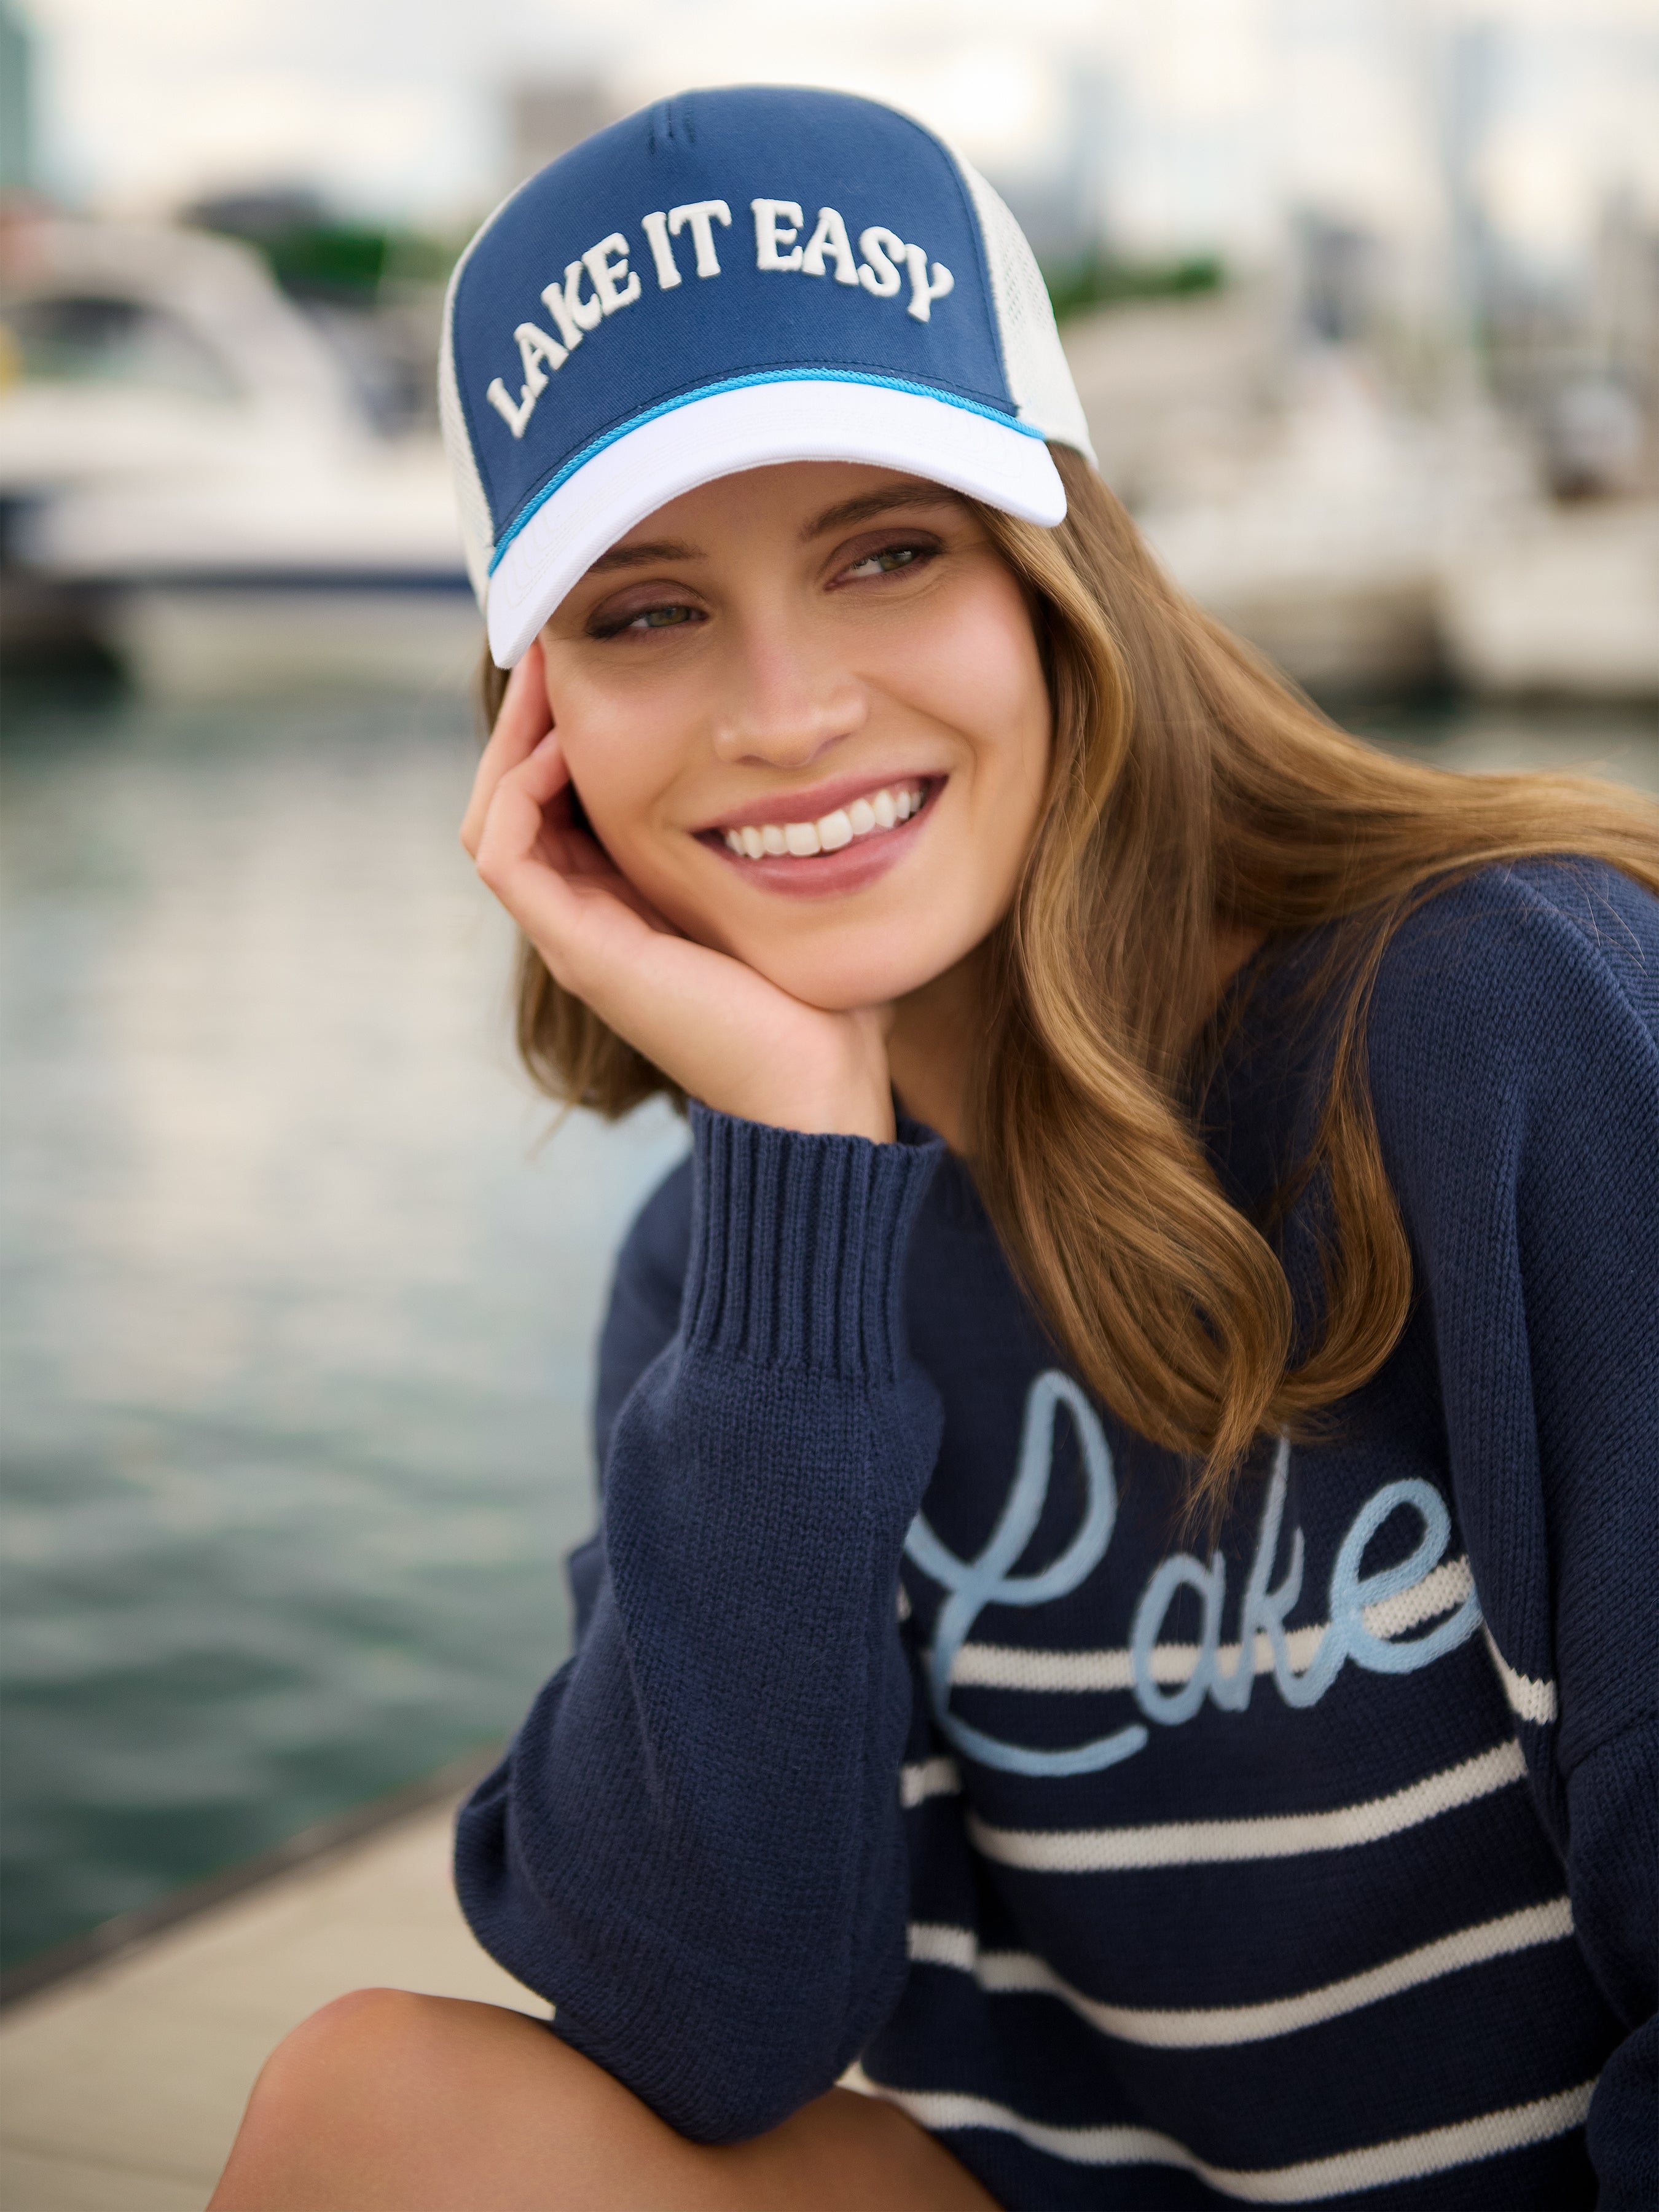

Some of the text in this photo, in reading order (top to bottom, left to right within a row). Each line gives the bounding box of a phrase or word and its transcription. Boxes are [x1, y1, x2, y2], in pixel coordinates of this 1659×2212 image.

[487, 197, 954, 438] LAKE IT EASY
[905, 1369, 1484, 1777] Lake
